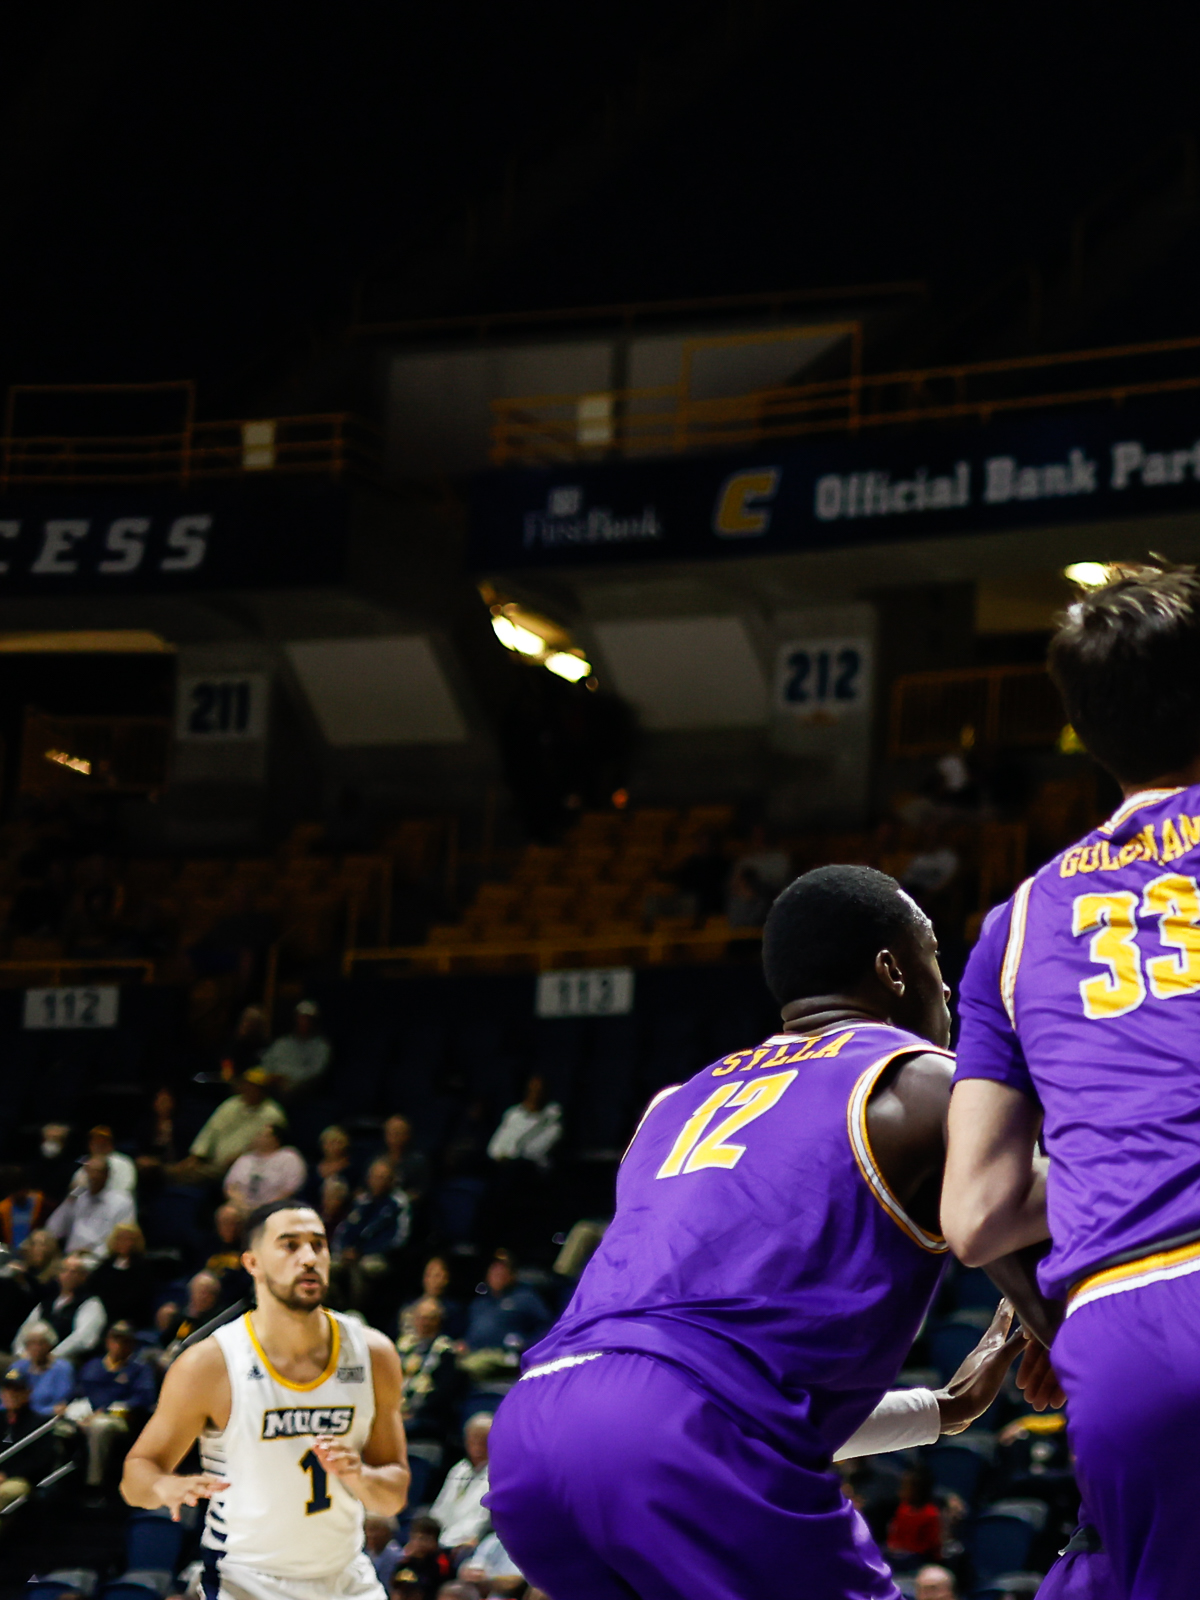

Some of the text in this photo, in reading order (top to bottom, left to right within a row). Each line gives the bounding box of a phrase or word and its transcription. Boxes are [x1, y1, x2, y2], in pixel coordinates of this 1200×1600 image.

[813, 460, 971, 522] Official
[983, 447, 1097, 505] Bank
[786, 651, 858, 701] 212
[190, 683, 249, 732] 211
[711, 1031, 856, 1077] SYLLA
[655, 1068, 799, 1180] 12
[263, 1408, 353, 1438] MOCS
[299, 1449, 332, 1516] 1
